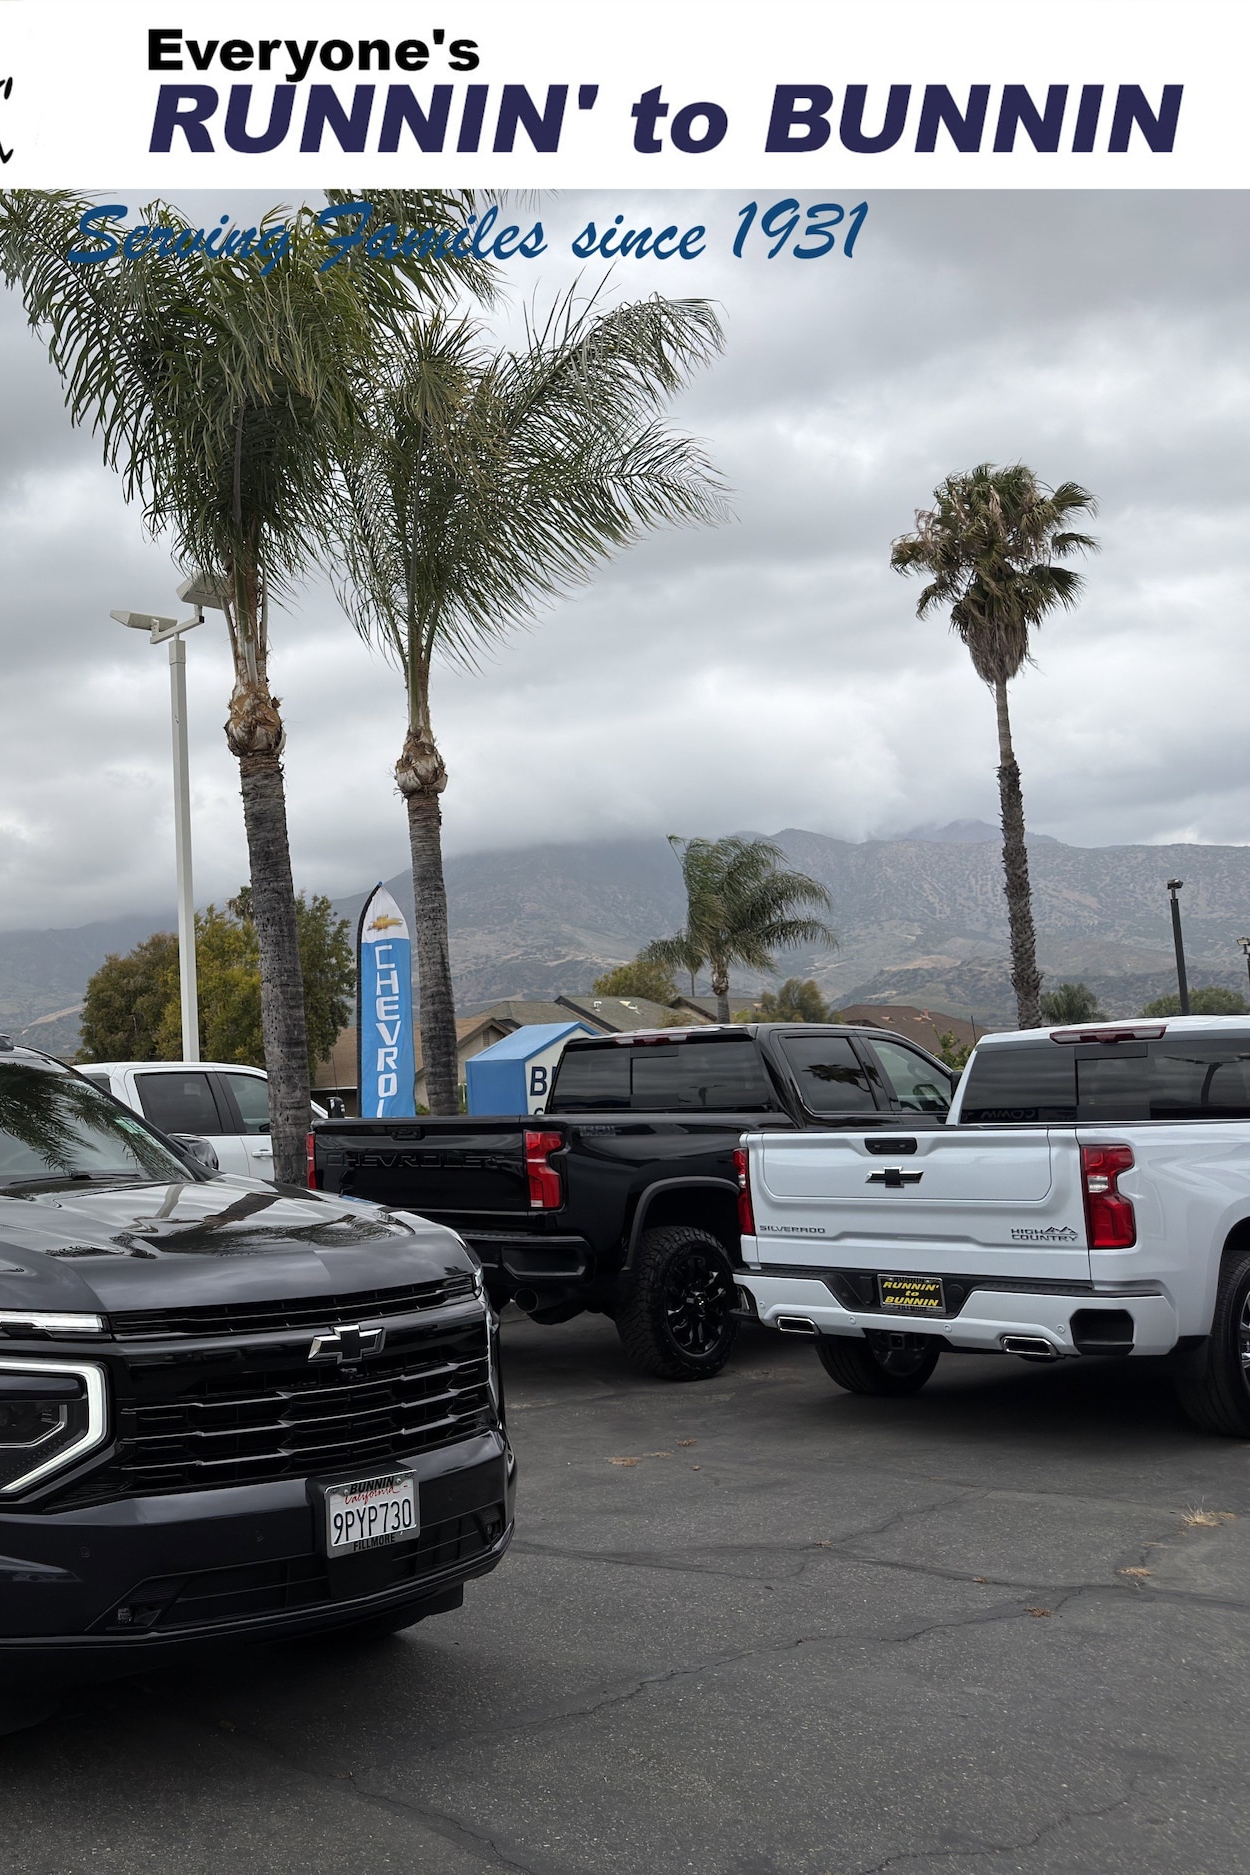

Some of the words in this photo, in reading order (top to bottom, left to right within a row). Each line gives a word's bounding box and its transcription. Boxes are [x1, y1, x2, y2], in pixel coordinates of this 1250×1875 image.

[759, 1225, 826, 1234] SILVERADO
[1011, 1234, 1079, 1242] COUNTRY
[882, 1281, 940, 1292] RUNNIN'
[884, 1296, 940, 1307] BUNNIN
[350, 1476, 395, 1495] BUNNIN
[344, 1485, 401, 1505] California
[333, 1498, 412, 1545] 9PYP730
[353, 1534, 396, 1552] FILLMORE
